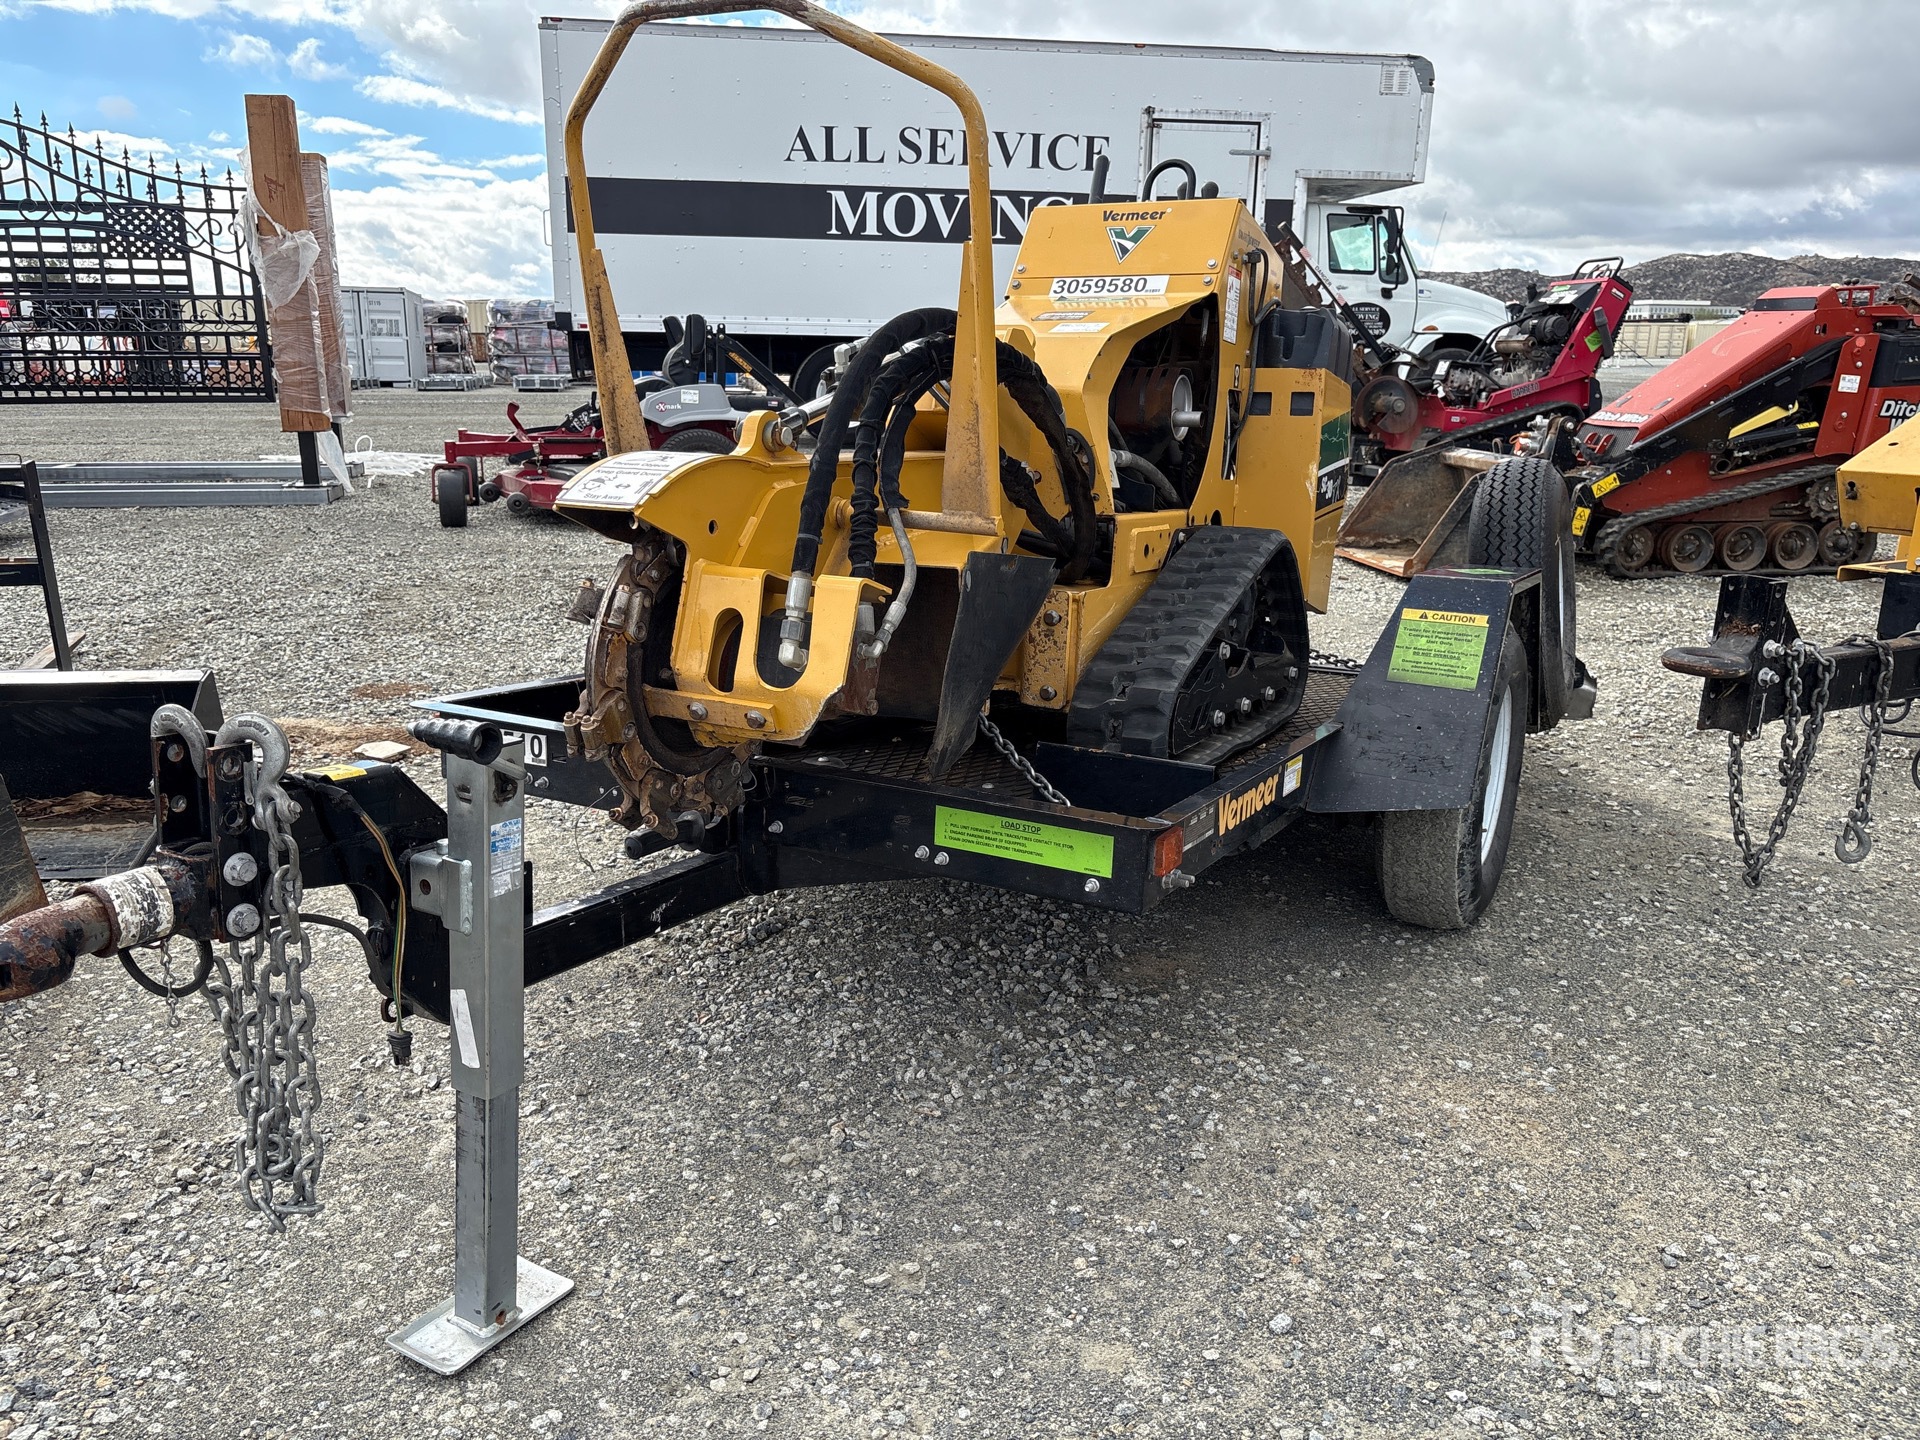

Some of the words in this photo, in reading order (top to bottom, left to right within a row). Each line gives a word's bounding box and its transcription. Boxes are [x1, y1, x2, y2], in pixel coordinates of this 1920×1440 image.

[784, 124, 886, 164] ALL
[1103, 208, 1167, 222] Vermeer
[1052, 277, 1148, 295] 3059580
[583, 492, 602, 500] Stay
[1432, 613, 1476, 624] CAUTION
[1218, 773, 1280, 837] Vermeer
[1001, 820, 1021, 830] LOAD
[1022, 823, 1041, 834] STOP
[966, 832, 985, 840] PARKING
[970, 826, 992, 835] FORWARD
[1033, 837, 1053, 846] CONTACT
[975, 840, 995, 849] SECURELY
